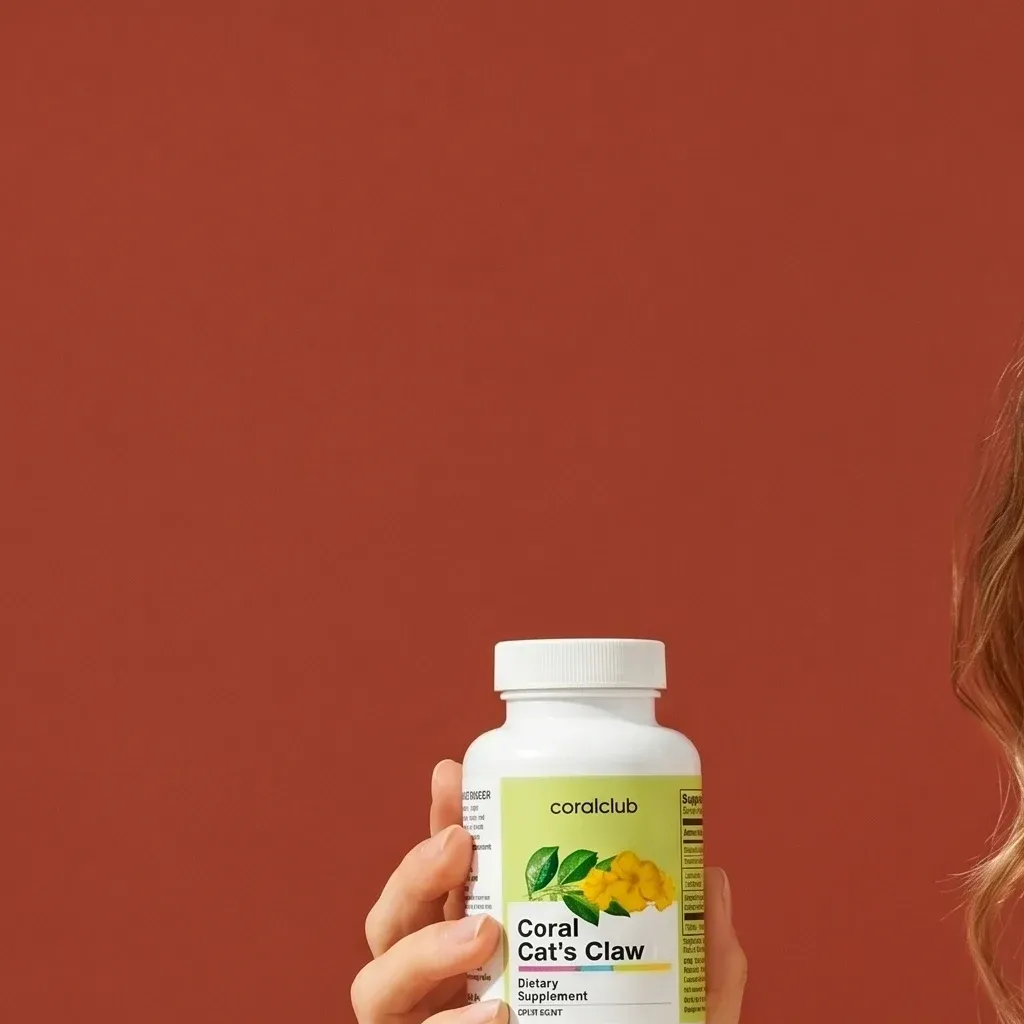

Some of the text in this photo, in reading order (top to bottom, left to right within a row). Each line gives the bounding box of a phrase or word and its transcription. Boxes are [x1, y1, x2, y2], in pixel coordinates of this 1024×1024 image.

[550, 797, 638, 814] coralclub
[517, 917, 579, 938] Coral
[517, 941, 645, 962] Cat's Claw
[518, 978, 559, 991] Dietary
[518, 990, 588, 1003] Supplement
